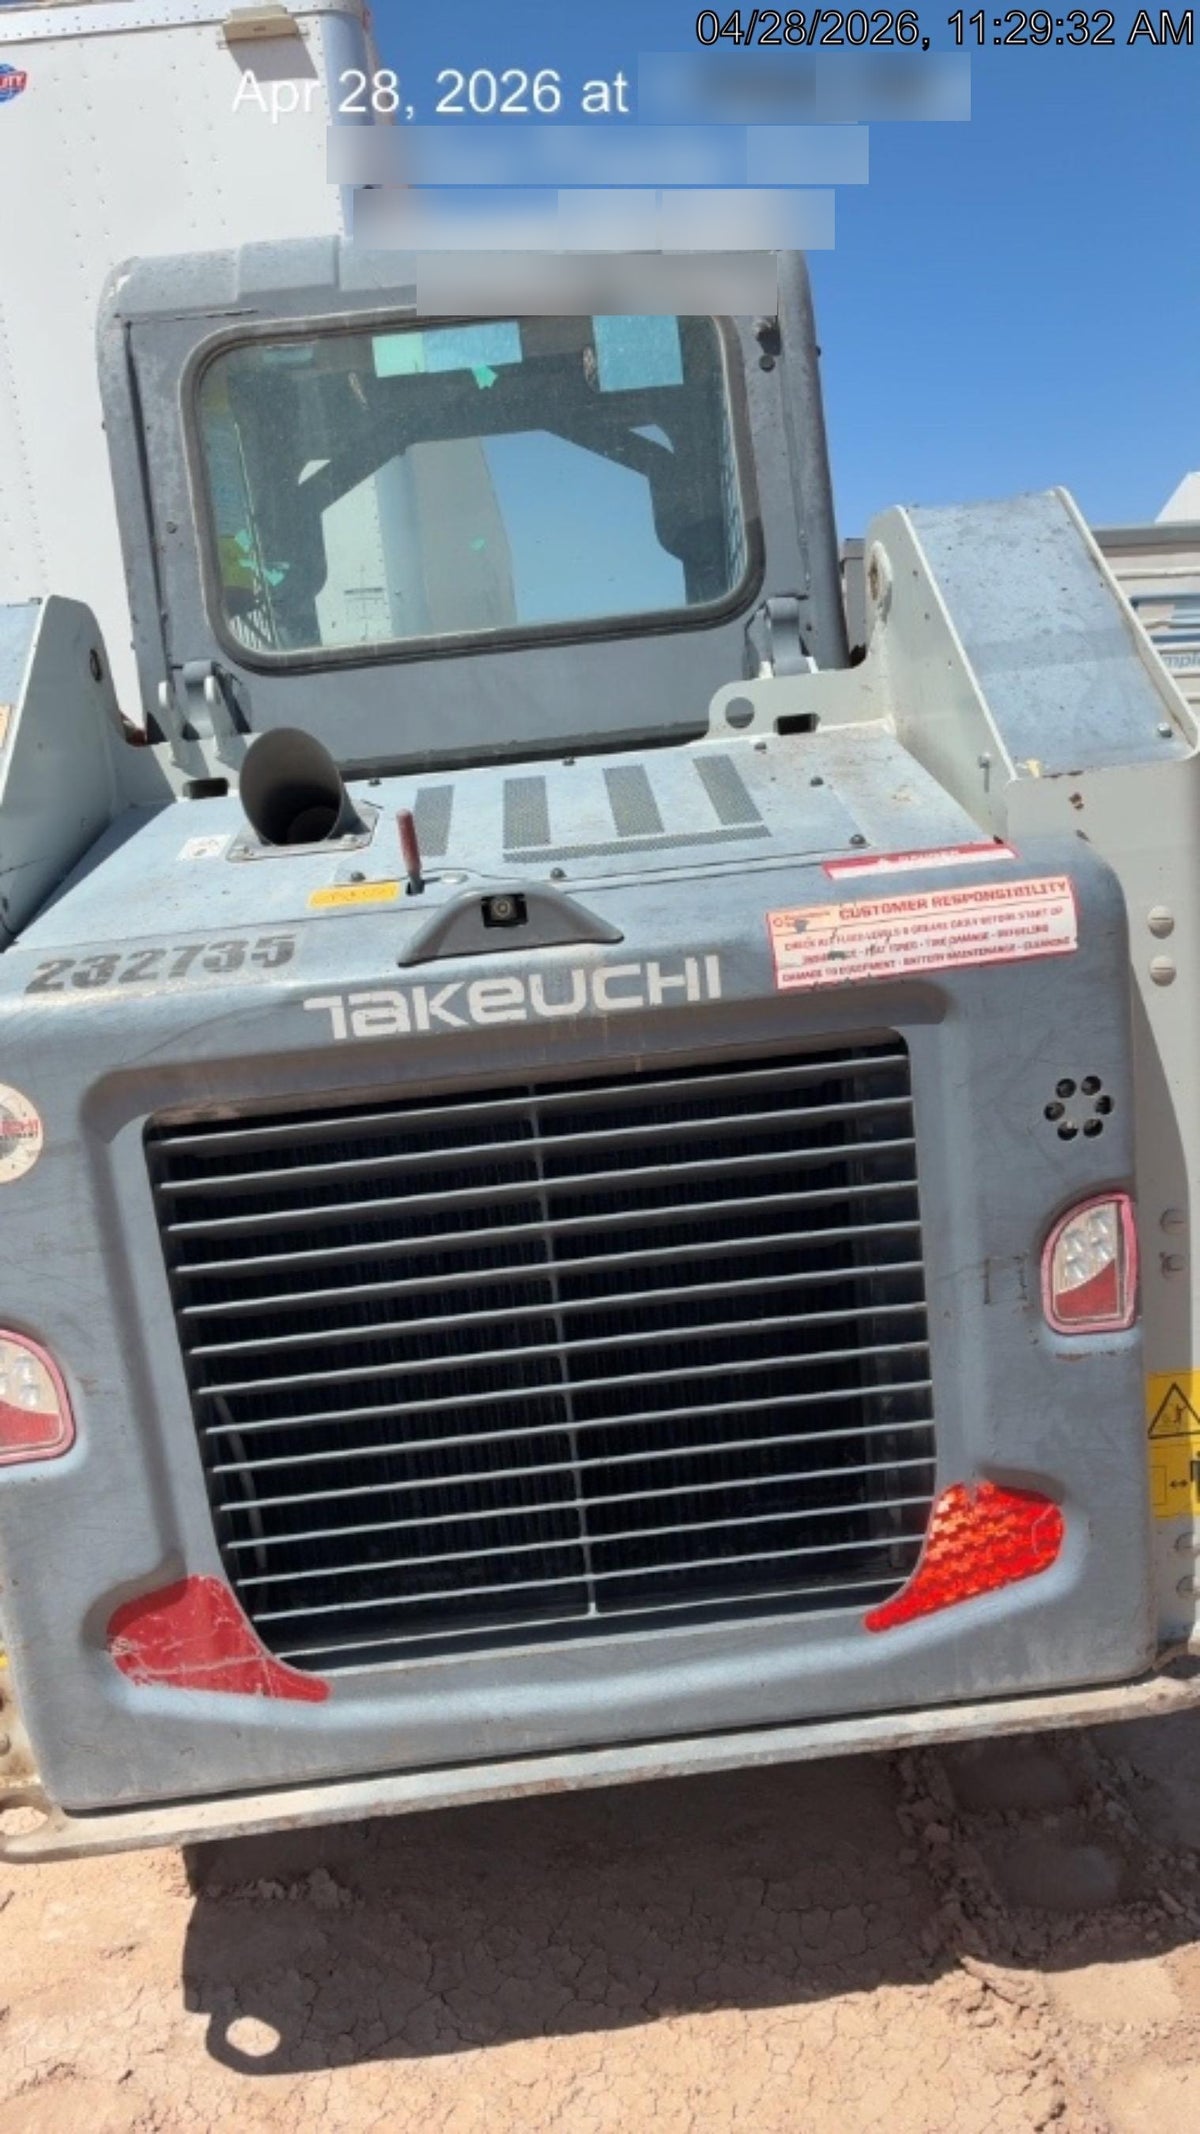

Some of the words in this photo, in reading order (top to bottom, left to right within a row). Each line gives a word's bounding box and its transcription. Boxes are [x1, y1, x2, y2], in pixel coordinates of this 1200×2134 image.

[839, 899, 928, 920] CUSTOMER
[931, 881, 1066, 908] RESPONSIBILITY
[25, 934, 298, 994] 232735
